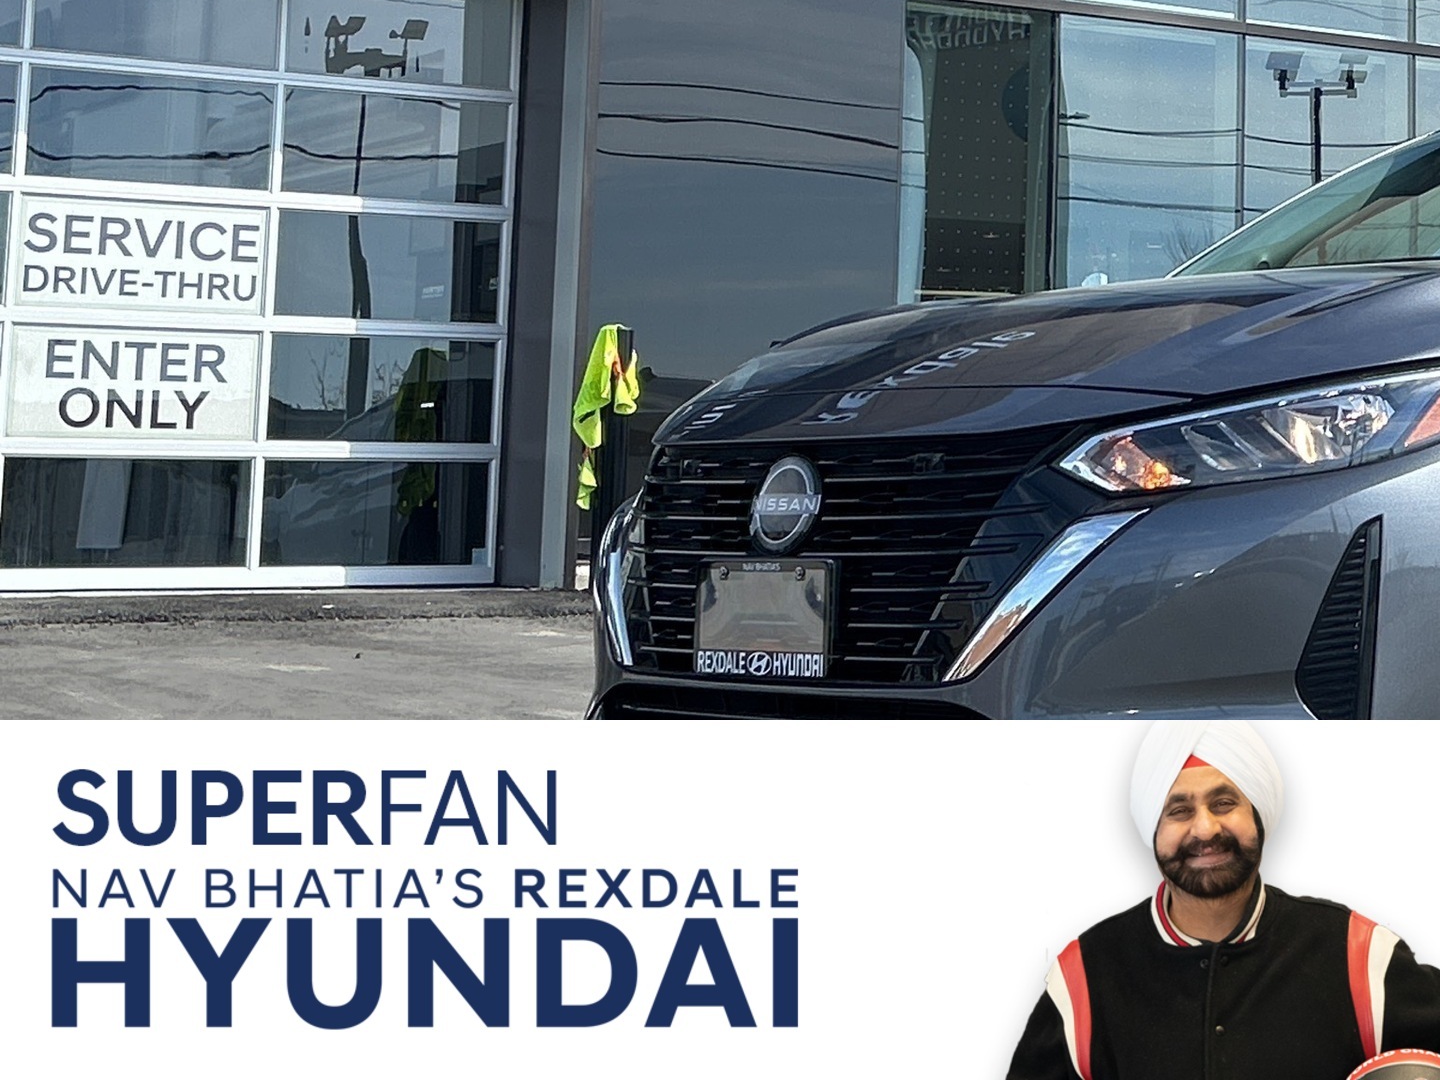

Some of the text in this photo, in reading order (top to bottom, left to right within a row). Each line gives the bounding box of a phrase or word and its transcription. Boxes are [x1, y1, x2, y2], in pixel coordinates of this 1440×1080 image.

[24, 212, 260, 263] SERVICE
[22, 264, 257, 302] DRIVE-THRU
[45, 339, 228, 384] ENTER
[58, 387, 211, 430] ONLY
[754, 496, 818, 513] NISSAN
[696, 650, 824, 677] REXDALE HYUNDAI
